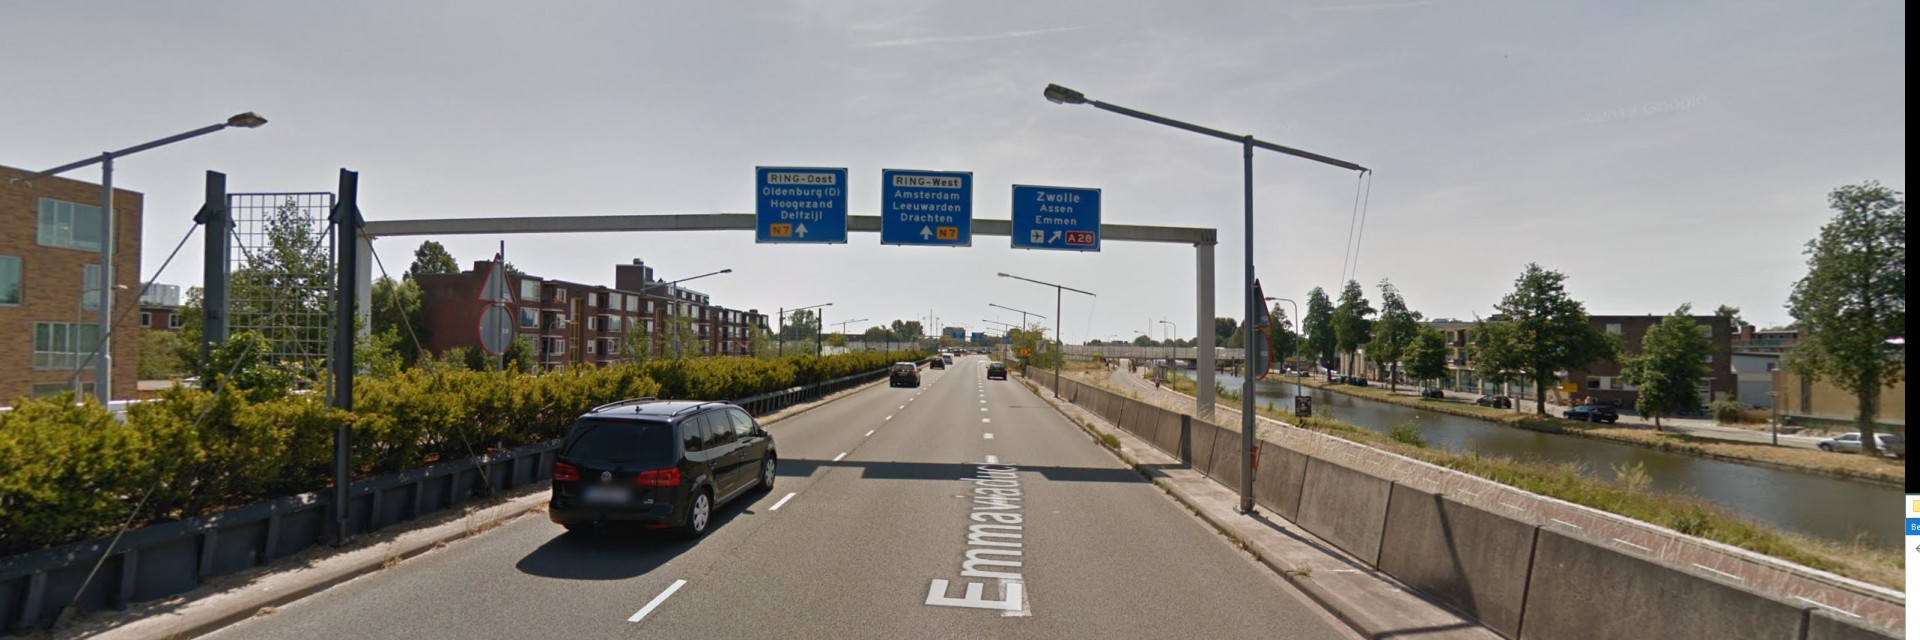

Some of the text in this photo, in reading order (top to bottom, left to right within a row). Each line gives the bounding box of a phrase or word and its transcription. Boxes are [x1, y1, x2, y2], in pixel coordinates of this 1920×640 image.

[770, 174, 833, 184] RING-Oost
[896, 176, 958, 187] RING-West
[763, 187, 840, 198] Oldenburg (D)
[894, 190, 960, 200] Amsterdam
[1036, 191, 1081, 203] Zwolle
[770, 200, 833, 210] Hoogezand
[892, 201, 961, 212] Leeuwarden
[1040, 204, 1073, 213] Assen
[780, 211, 823, 222] Delfzijl
[900, 213, 953, 223] Drachten
[1035, 215, 1077, 226] Emmen
